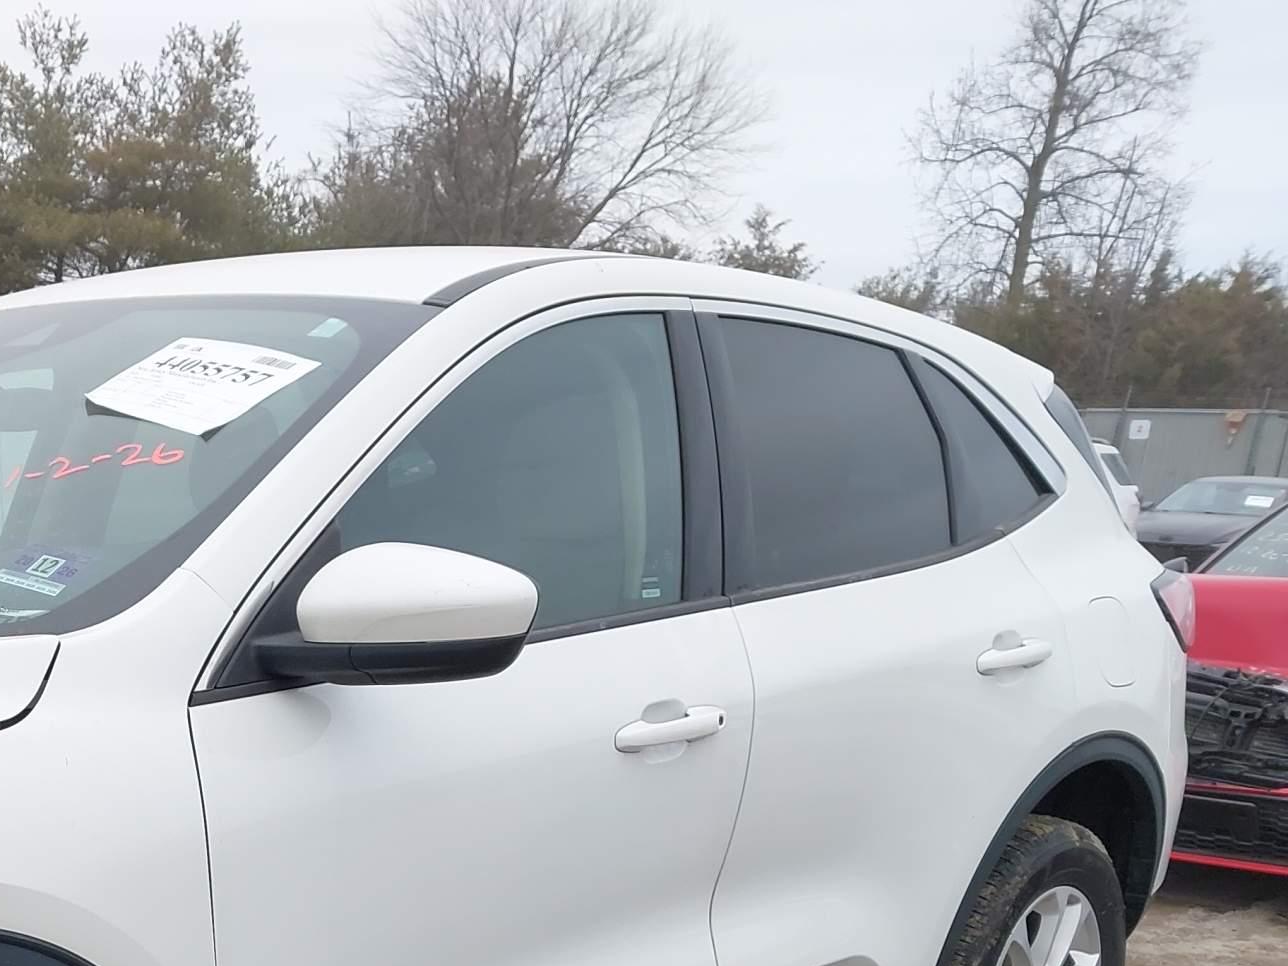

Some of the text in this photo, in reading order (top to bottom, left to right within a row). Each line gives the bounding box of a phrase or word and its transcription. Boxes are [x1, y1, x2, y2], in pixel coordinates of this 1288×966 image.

[154, 355, 274, 387] 44055757
[4, 442, 185, 488] 1-2-26
[31, 557, 61, 574] 12
